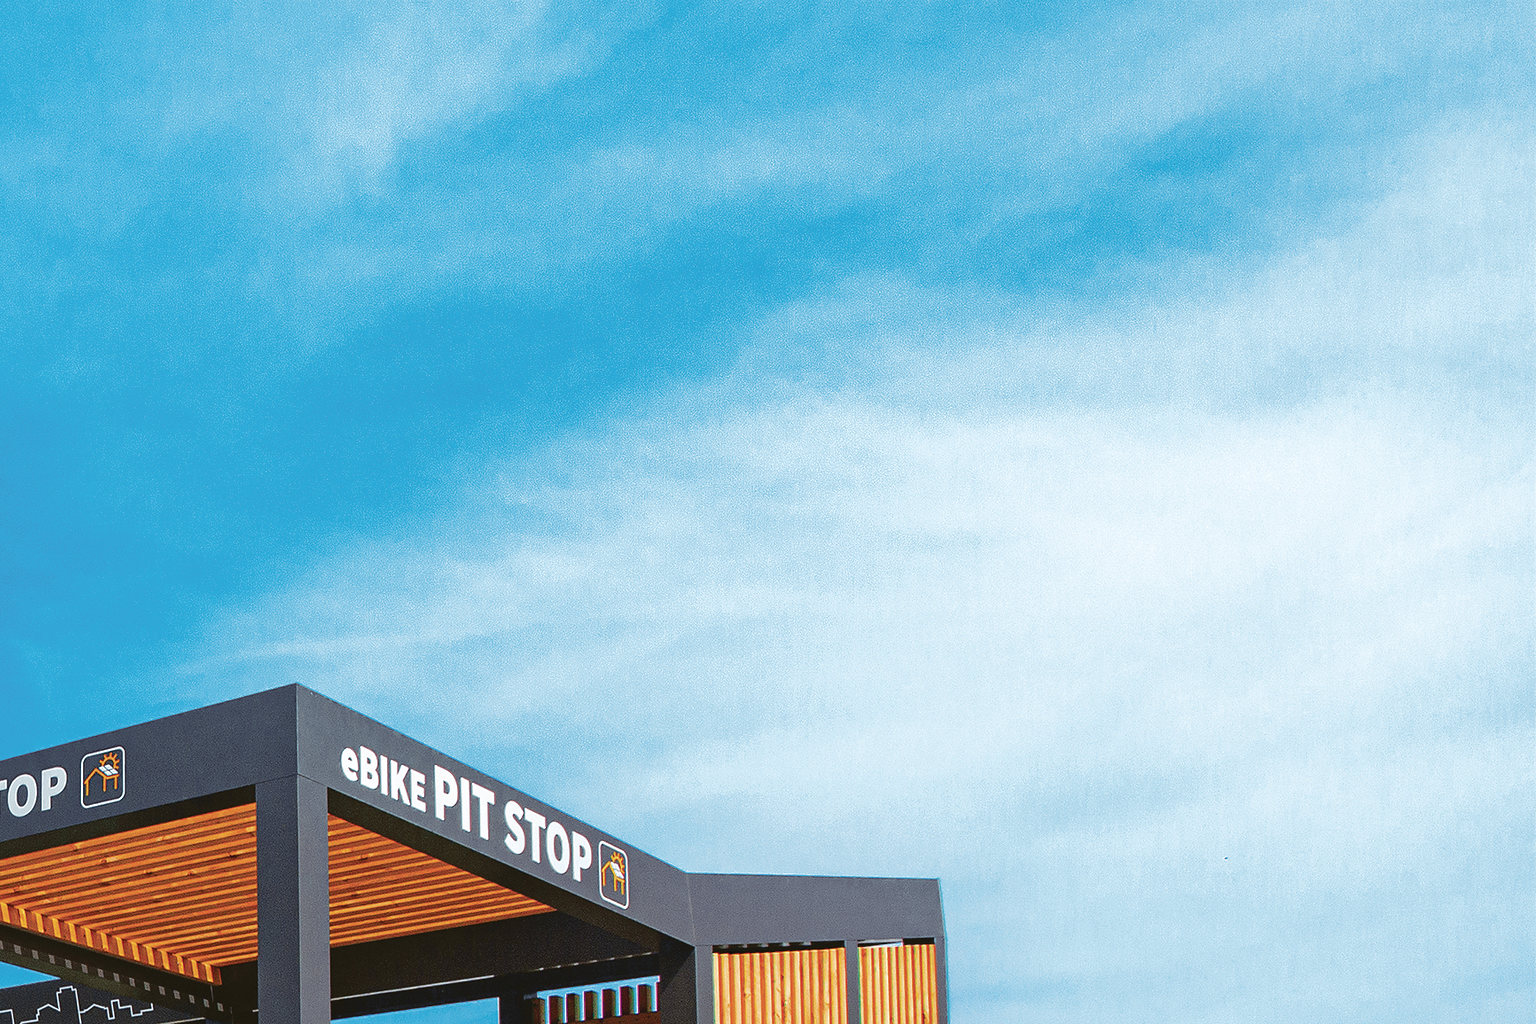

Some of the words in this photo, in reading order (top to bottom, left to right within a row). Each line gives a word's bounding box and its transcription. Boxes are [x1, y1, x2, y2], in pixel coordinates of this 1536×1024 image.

[340, 745, 427, 813] eBIKE
[434, 764, 496, 841] PIT
[504, 800, 593, 883] STOP
